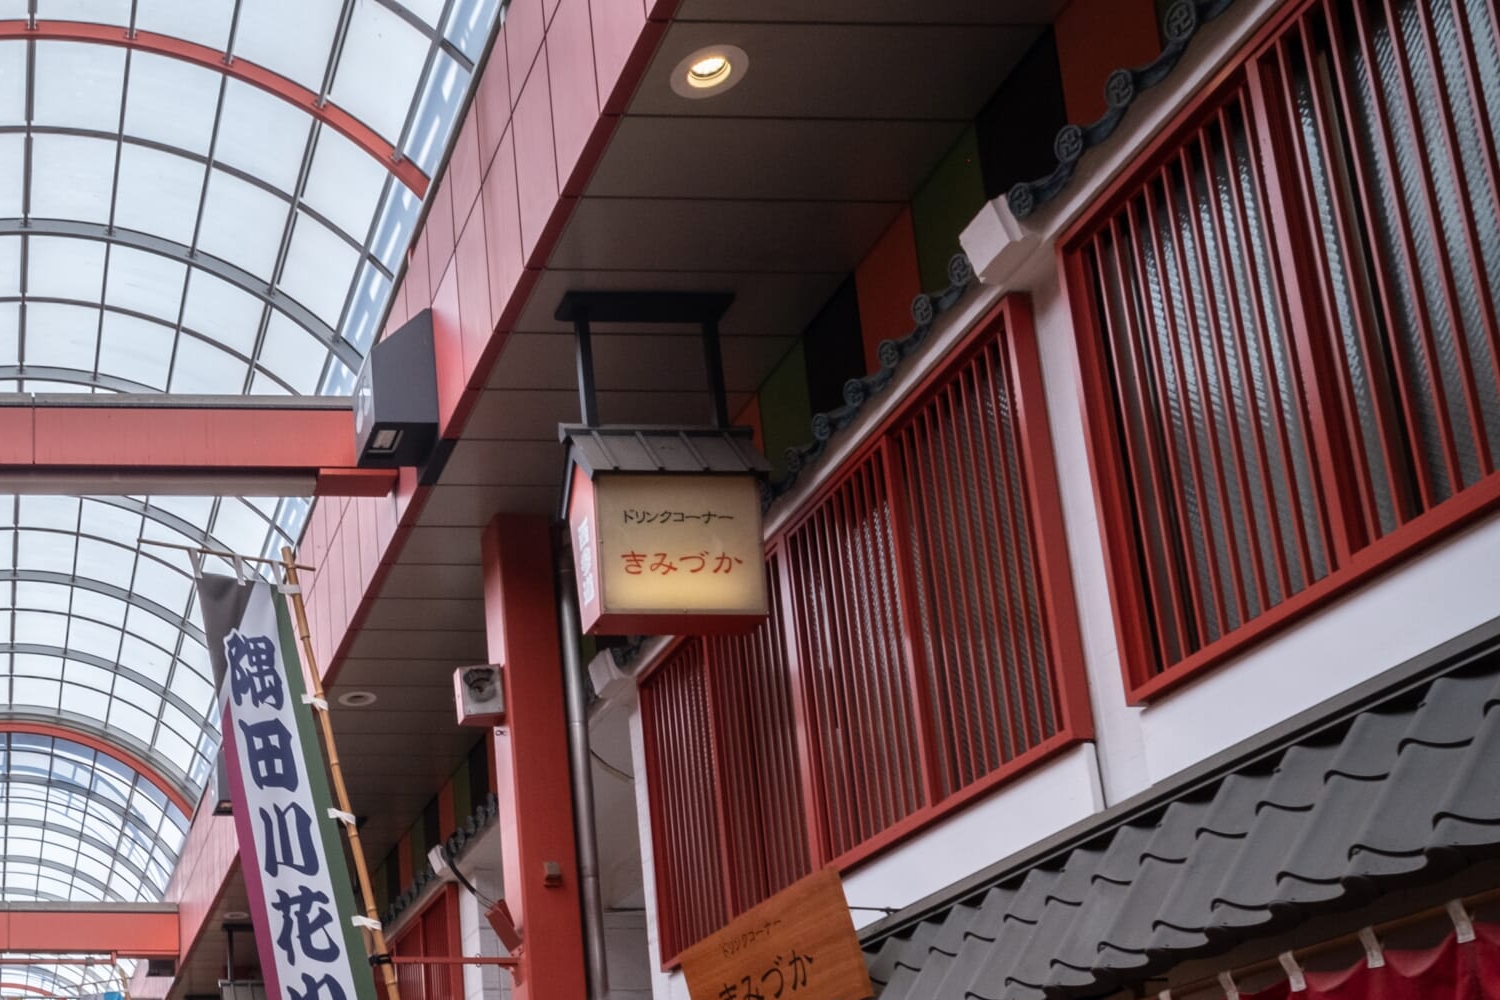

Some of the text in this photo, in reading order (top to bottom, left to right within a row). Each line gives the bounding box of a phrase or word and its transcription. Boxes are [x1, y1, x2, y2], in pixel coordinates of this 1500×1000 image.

[623, 509, 734, 525] ドリンクコーナー
[621, 550, 743, 576] きみづか
[722, 919, 784, 958] ドリンクコーナー
